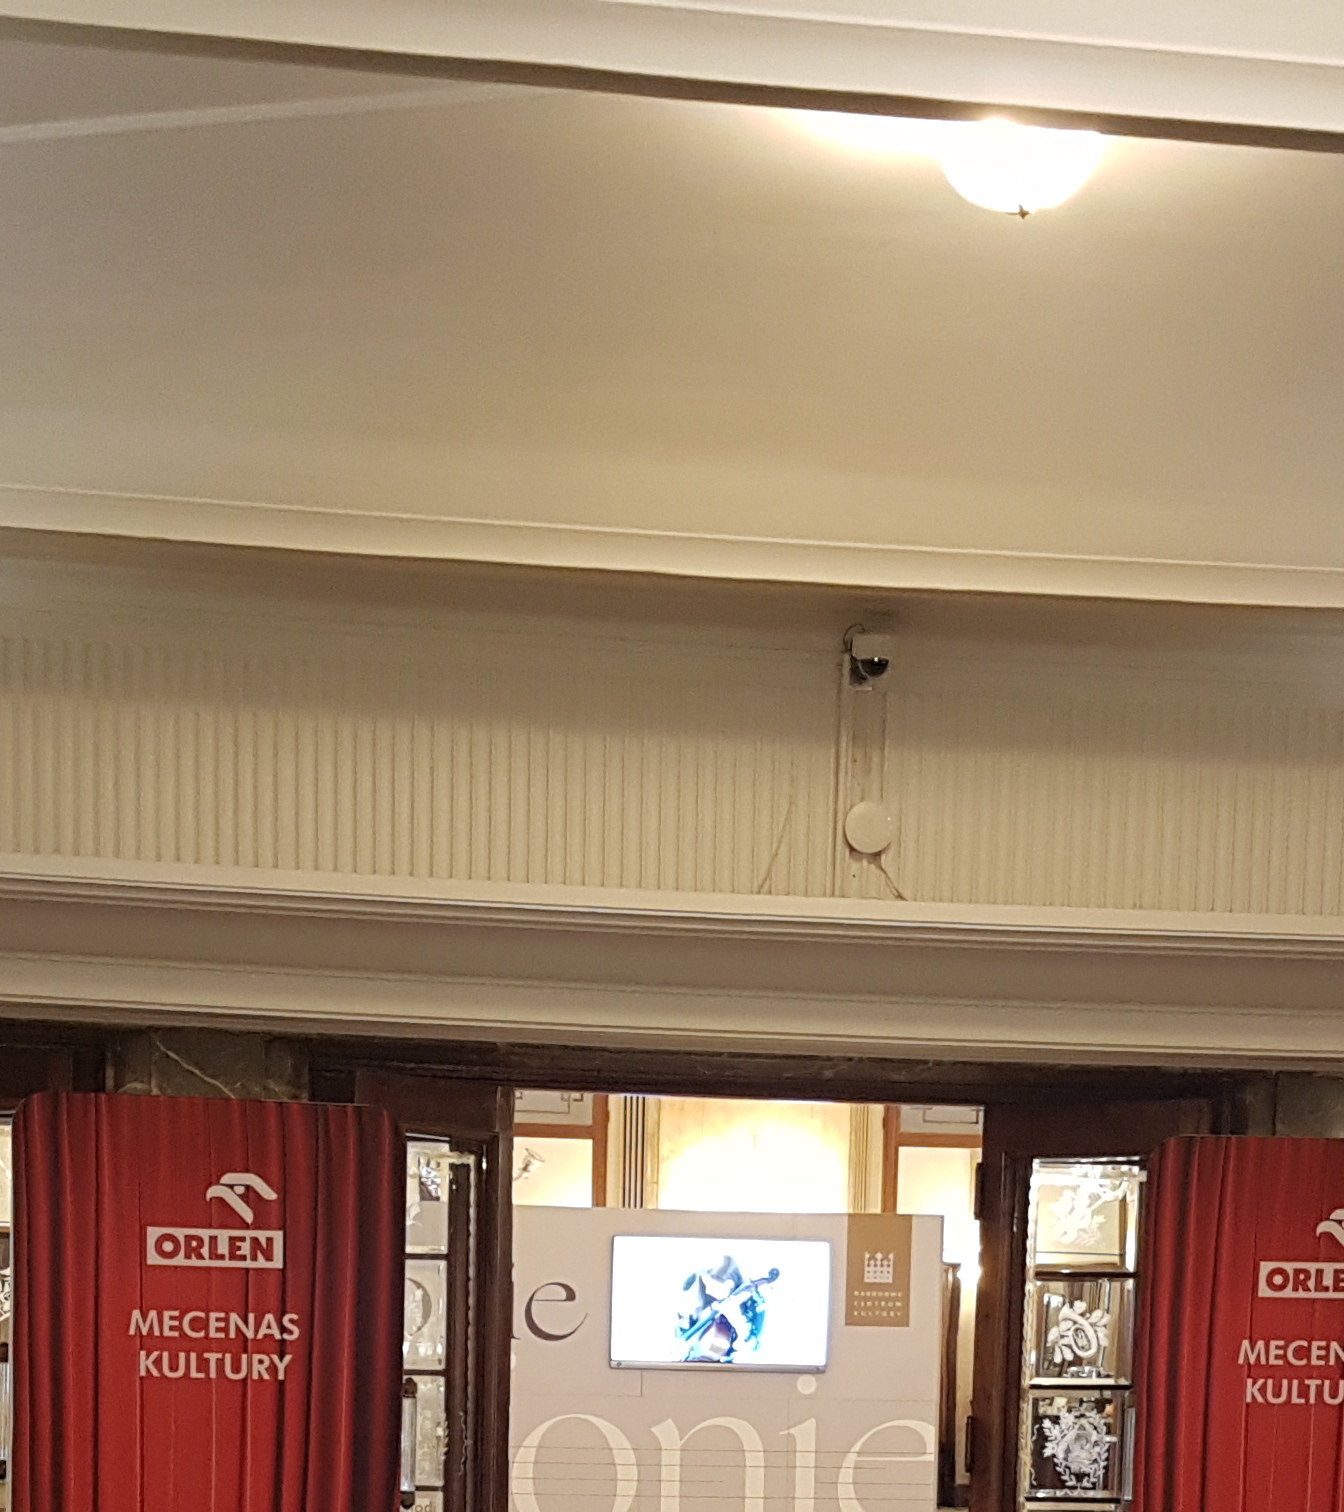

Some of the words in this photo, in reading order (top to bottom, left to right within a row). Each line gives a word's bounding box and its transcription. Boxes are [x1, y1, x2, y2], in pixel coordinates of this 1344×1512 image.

[154, 1233, 275, 1262] ORLEN
[128, 1309, 301, 1341] MECENAS
[139, 1350, 293, 1381] KULTURY
